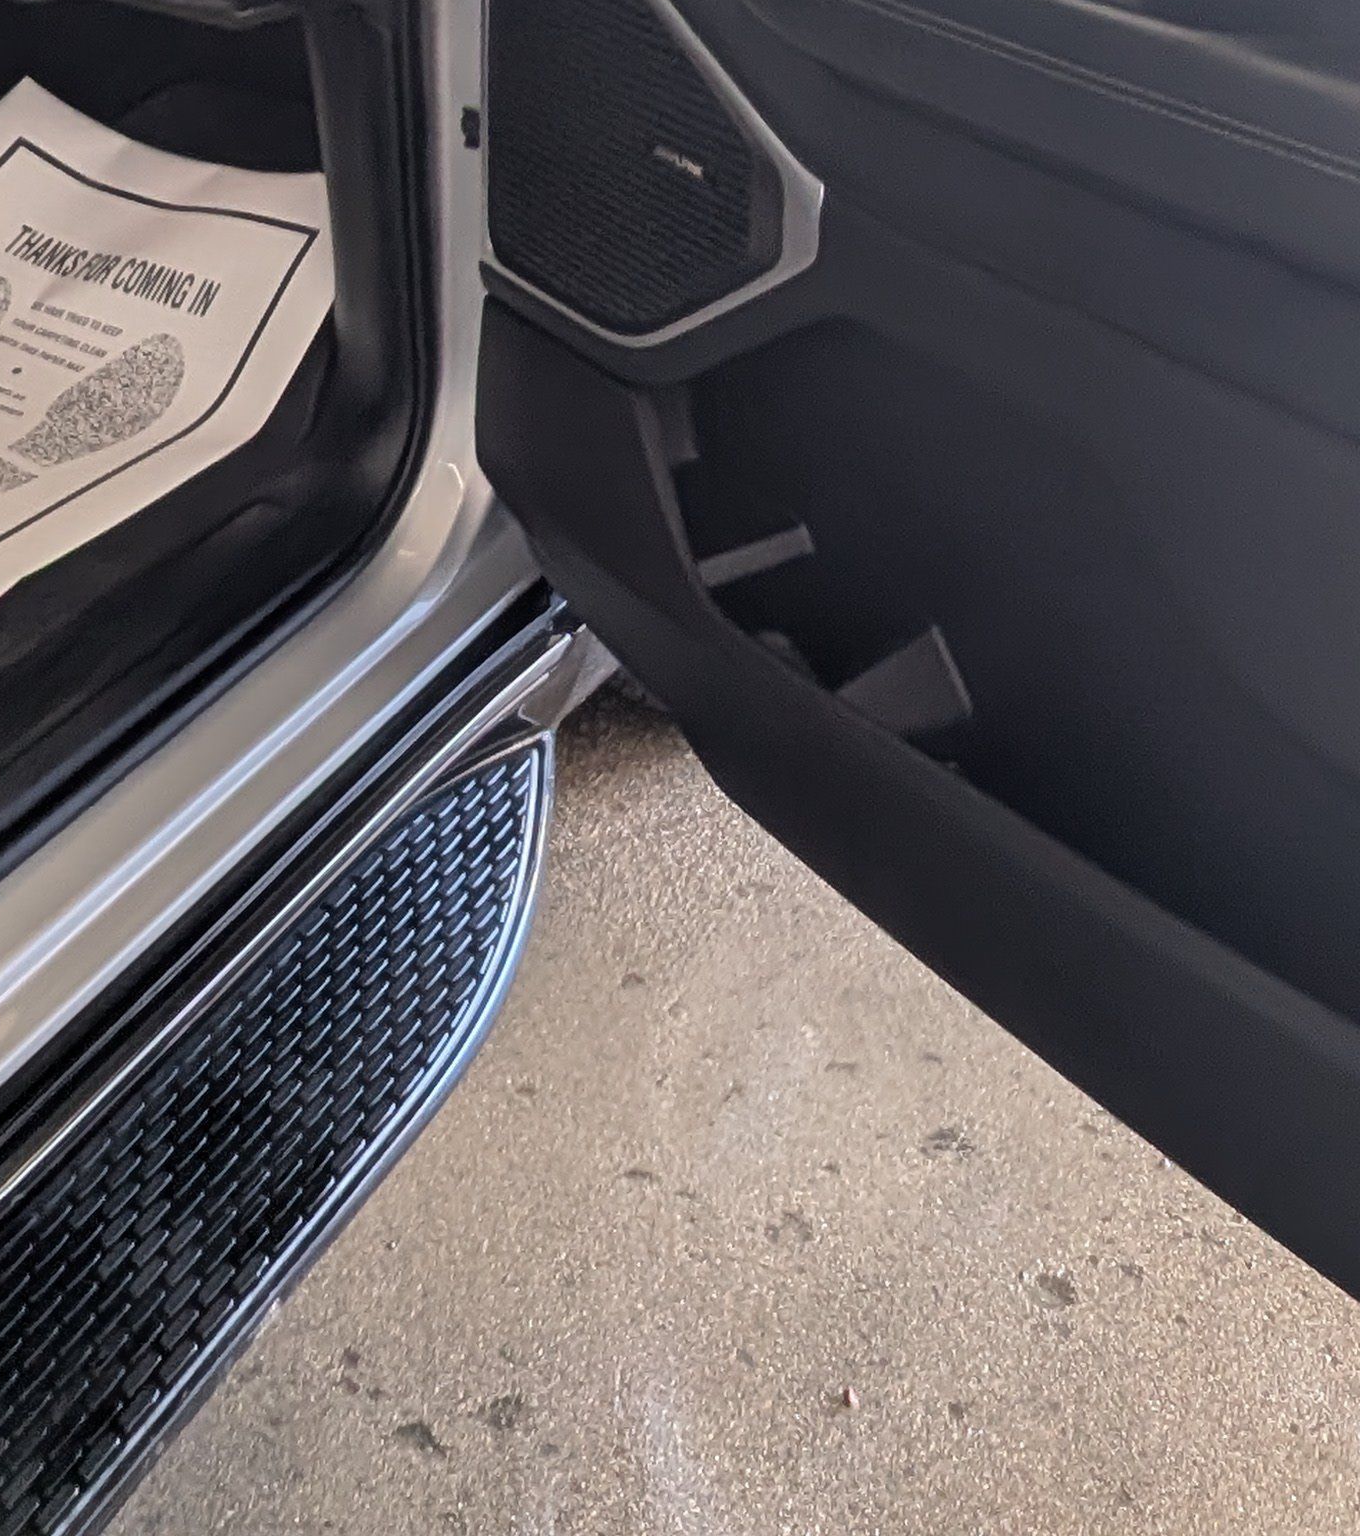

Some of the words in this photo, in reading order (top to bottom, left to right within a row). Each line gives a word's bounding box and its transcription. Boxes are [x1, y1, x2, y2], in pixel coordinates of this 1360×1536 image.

[4, 224, 88, 277] THANKS
[74, 253, 122, 285] FOR
[111, 257, 195, 309] COMING
[187, 278, 221, 317] IN
